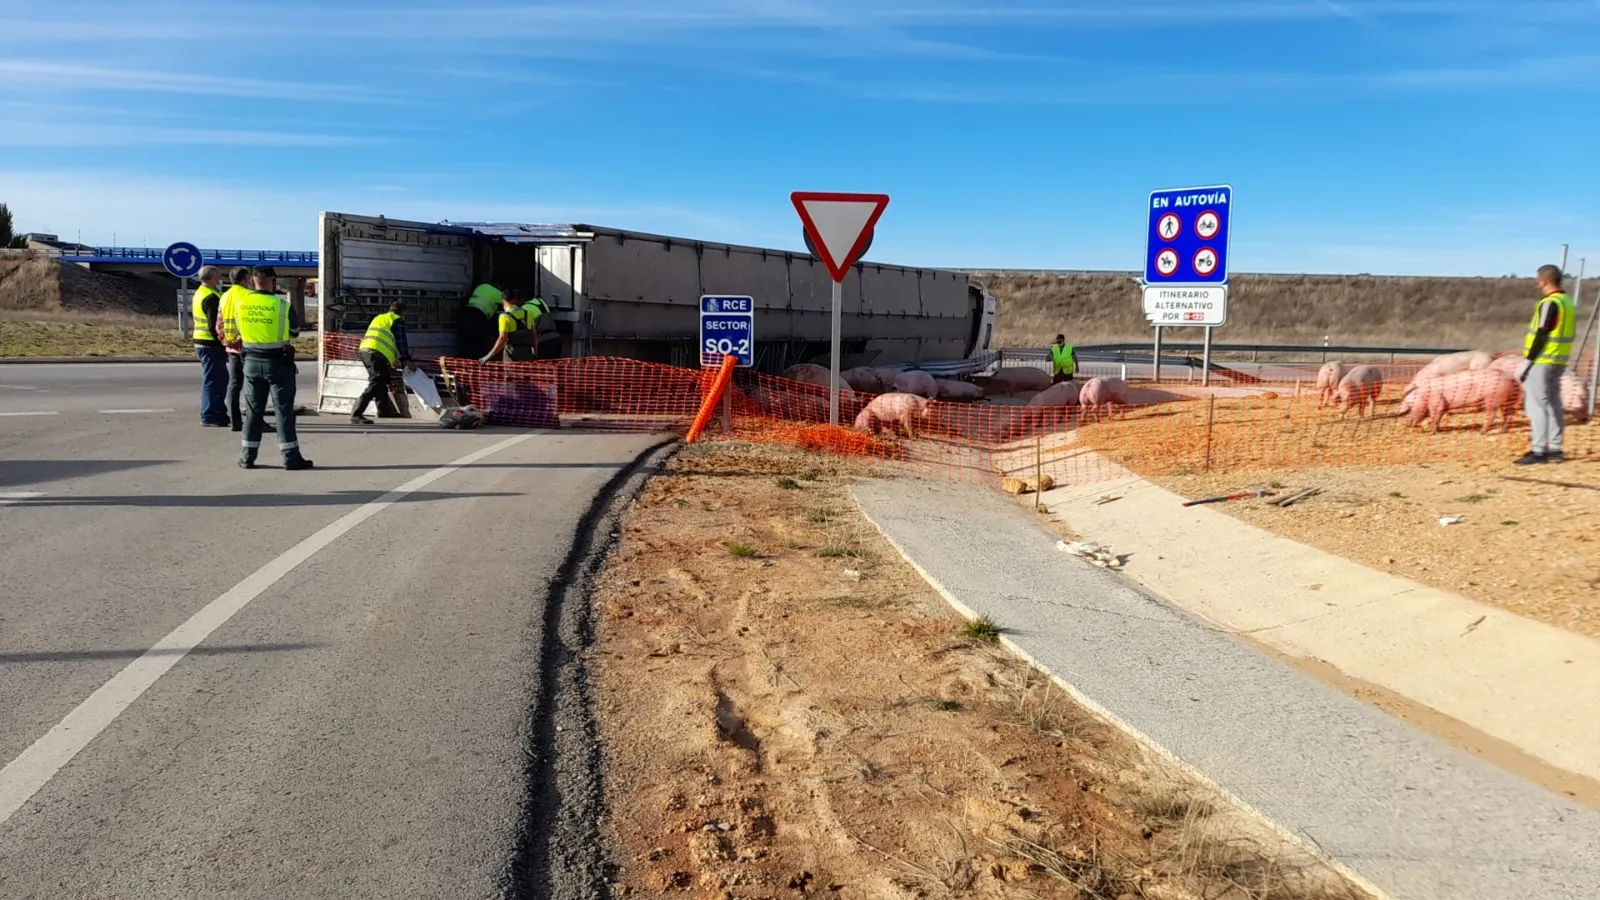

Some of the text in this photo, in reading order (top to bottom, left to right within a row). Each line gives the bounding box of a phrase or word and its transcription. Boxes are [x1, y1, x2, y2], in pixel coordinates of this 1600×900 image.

[1153, 192, 1226, 208] EN AUTOVÍA
[1159, 291, 1209, 299] ITINERARIO
[723, 300, 747, 310] RCE
[1155, 301, 1213, 310] ALTERNATIVO
[1162, 312, 1179, 320] POR
[706, 321, 747, 330] SECTOR
[705, 338, 748, 354] SO-2
